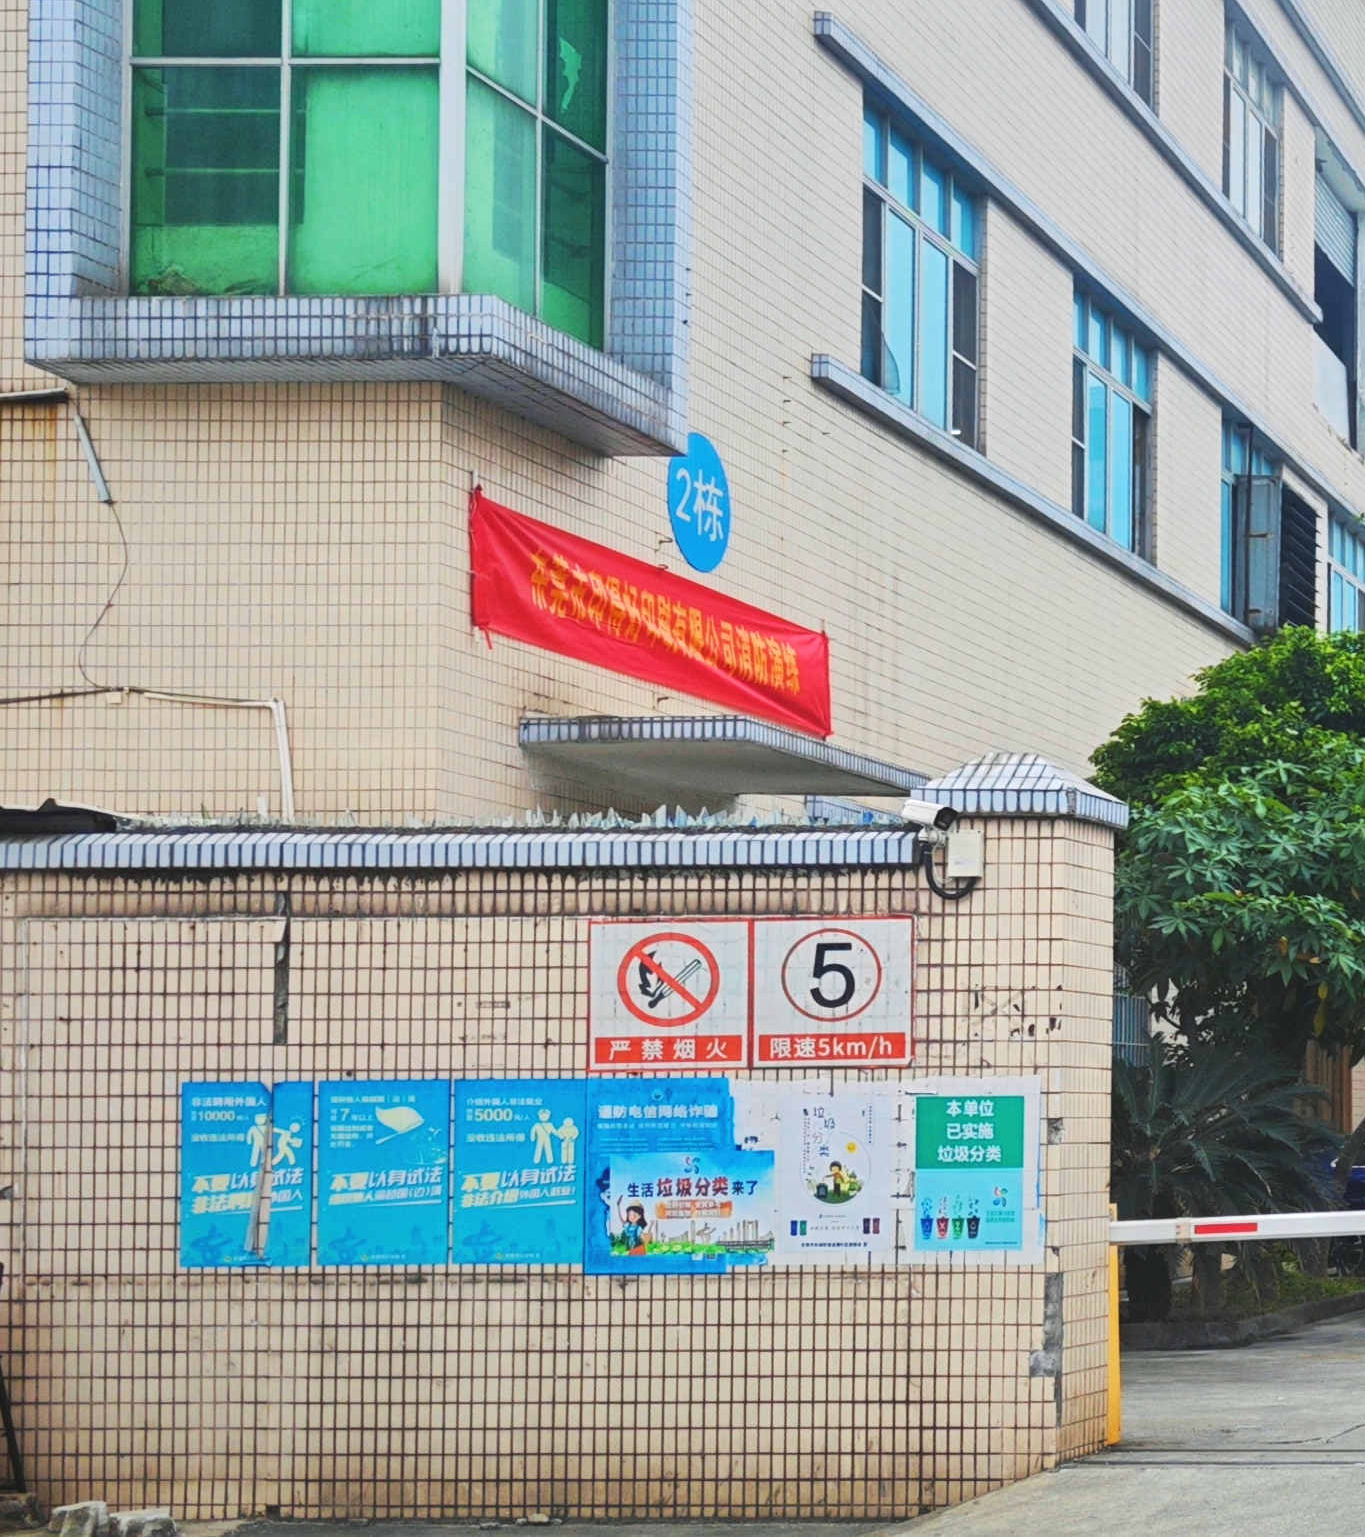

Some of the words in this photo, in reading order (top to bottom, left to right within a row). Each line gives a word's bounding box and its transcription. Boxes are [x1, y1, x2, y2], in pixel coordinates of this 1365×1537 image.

[675, 467, 724, 543] 2栋
[810, 942, 856, 1008] 5
[608, 1038, 728, 1061] 严禁烟火
[769, 1035, 893, 1059] 限速5km/h
[946, 1099, 995, 1117] 本单位
[946, 1122, 995, 1140] 已实施
[937, 1144, 1002, 1162] 垃圾分类
[330, 1166, 443, 1192] 不要以身试法
[461, 1165, 577, 1192] 不要以身试法
[627, 1176, 759, 1198] 生活垃圾分类来了
